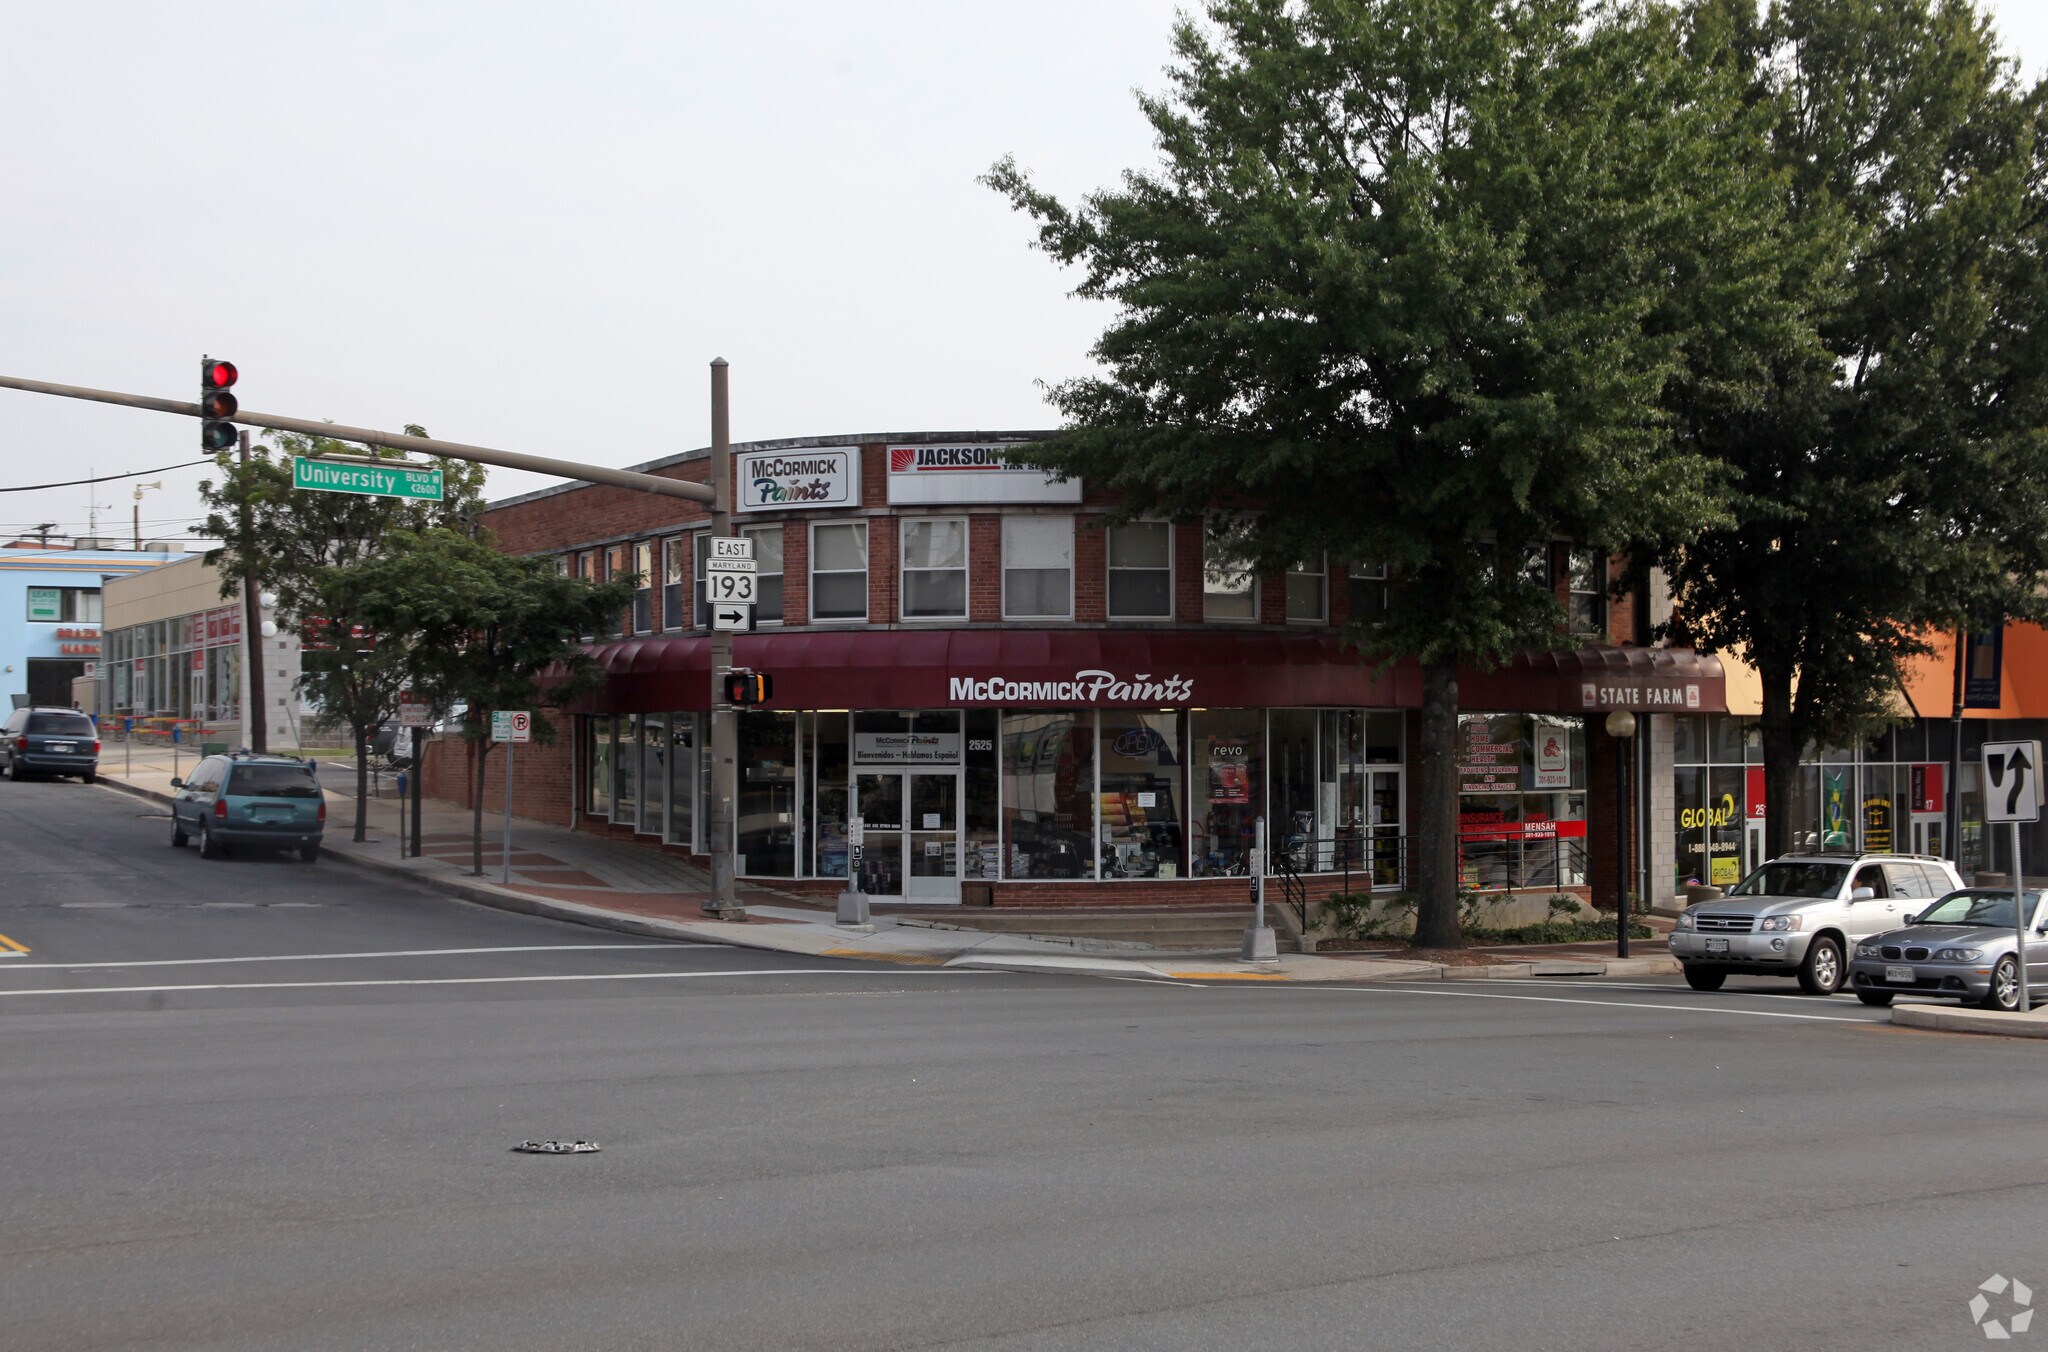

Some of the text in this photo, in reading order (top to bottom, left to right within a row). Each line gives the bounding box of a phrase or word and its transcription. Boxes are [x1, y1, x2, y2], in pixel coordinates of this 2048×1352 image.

[300, 464, 396, 494] University
[405, 473, 440, 484] BLVD W
[753, 478, 832, 503] Paints
[718, 541, 746, 556] EAST
[712, 561, 752, 570] MARYLAND
[711, 575, 752, 599] 193
[1075, 669, 1194, 701] Paints
[1600, 687, 1683, 704] STATE FARM
[1115, 733, 1157, 752] OPEN
[1471, 735, 1490, 743] HOME
[968, 740, 993, 751] 2525
[1213, 745, 1243, 756] revo
[1471, 744, 1514, 753] COMMERCIAL
[857, 750, 895, 758] Bienvenidos
[902, 750, 933, 759] Hablamos
[934, 750, 959, 760] Español
[1471, 754, 1496, 763] HEALTH
[1459, 766, 1519, 774] PROVIDING INSURANCE
[1484, 774, 1496, 782] AND
[1463, 783, 1516, 791] FINANCIAL SERVICES
[1681, 808, 1728, 828] GLOBAL
[1525, 822, 1556, 831] MENSAH
[1713, 867, 1735, 877] GLOBAL
